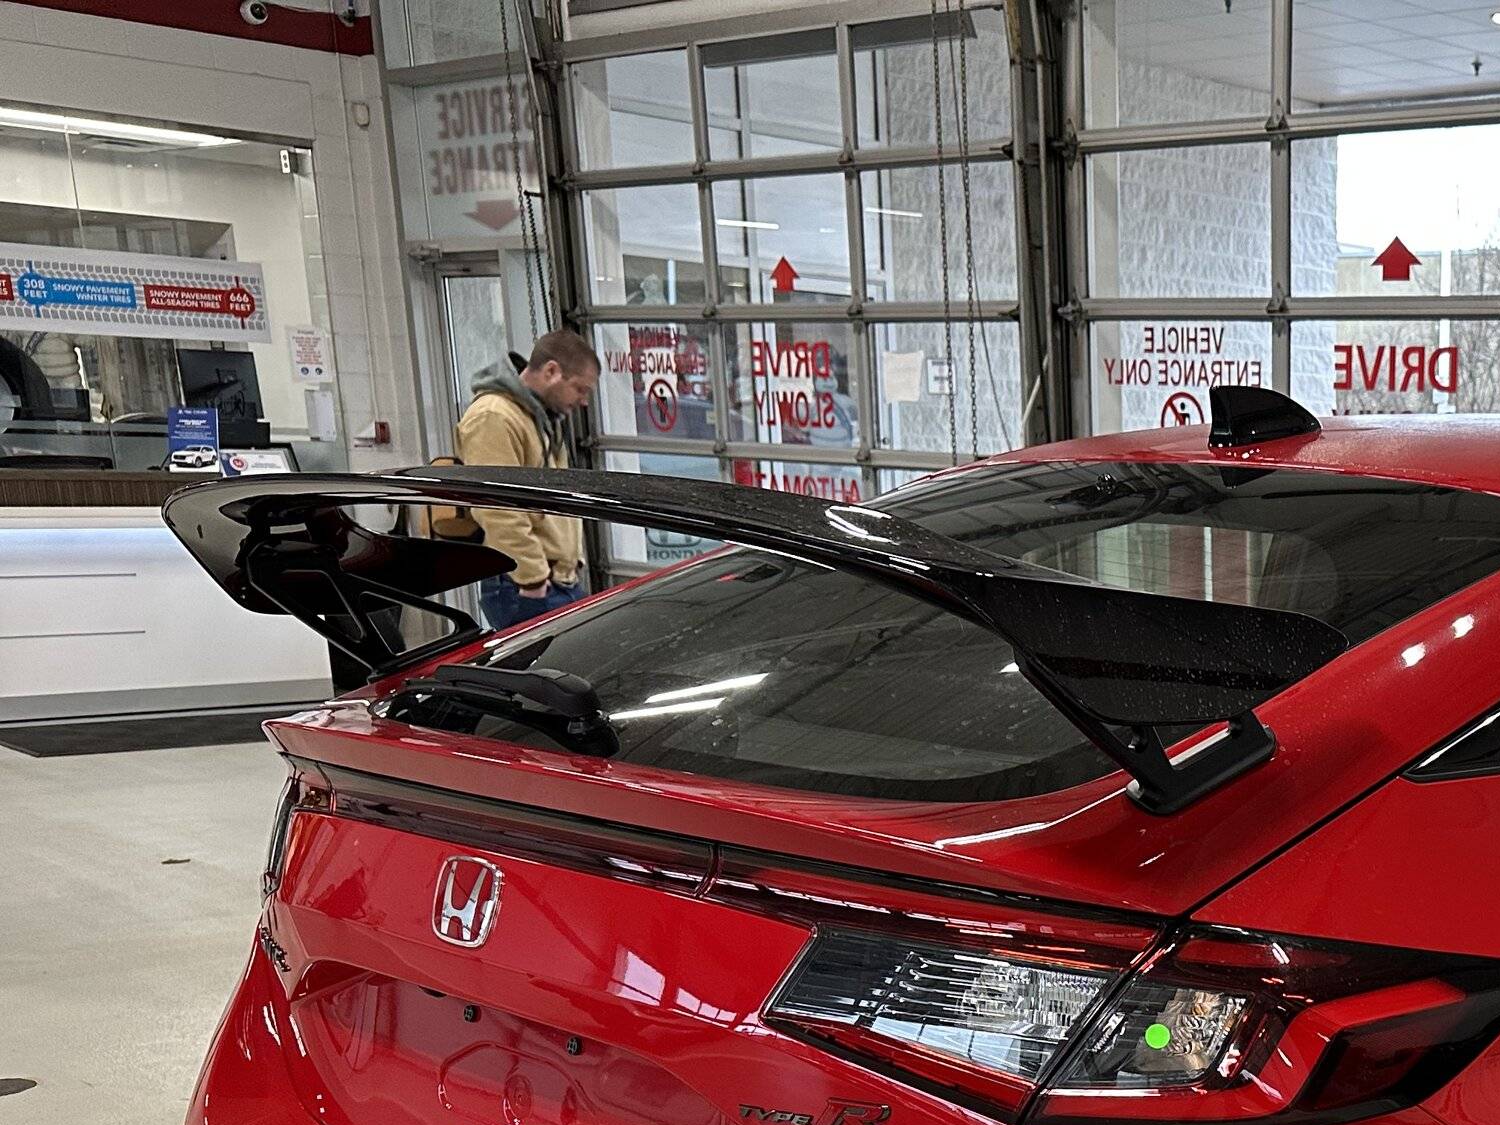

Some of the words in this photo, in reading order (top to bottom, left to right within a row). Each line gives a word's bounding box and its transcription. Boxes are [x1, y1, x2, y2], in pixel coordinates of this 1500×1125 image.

[23, 278, 45, 289] 308
[23, 289, 48, 299] FEET
[53, 283, 84, 292] SNOWY
[86, 285, 130, 295] PAVEMENT
[76, 293, 107, 302] WINTER
[109, 295, 131, 303] TIRES
[150, 290, 179, 298] SNOWY
[181, 292, 222, 301] PAVEMENT
[229, 293, 249, 302] 666
[199, 300, 220, 308] TIRES
[229, 302, 251, 311] FEET
[647, 549, 704, 560] HONDA
